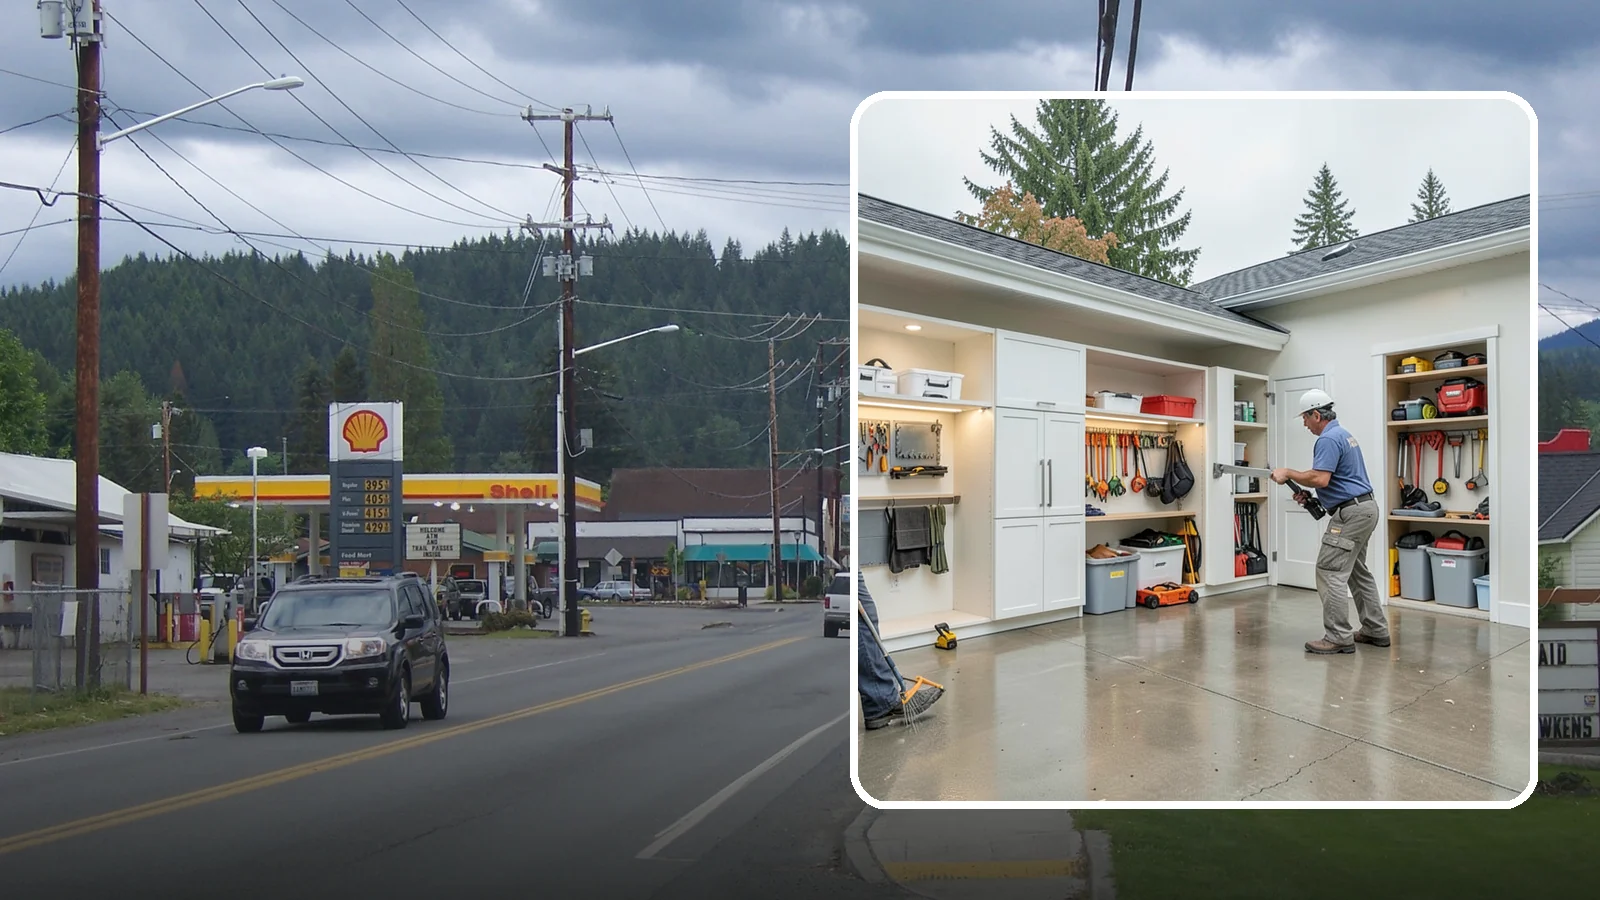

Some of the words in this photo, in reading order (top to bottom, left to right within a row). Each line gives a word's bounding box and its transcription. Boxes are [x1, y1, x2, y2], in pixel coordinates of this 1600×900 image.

[366, 480, 383, 490] 395
[490, 484, 547, 498] Shell
[366, 494, 383, 503] 405
[366, 508, 383, 517] 415
[366, 523, 383, 532] 429
